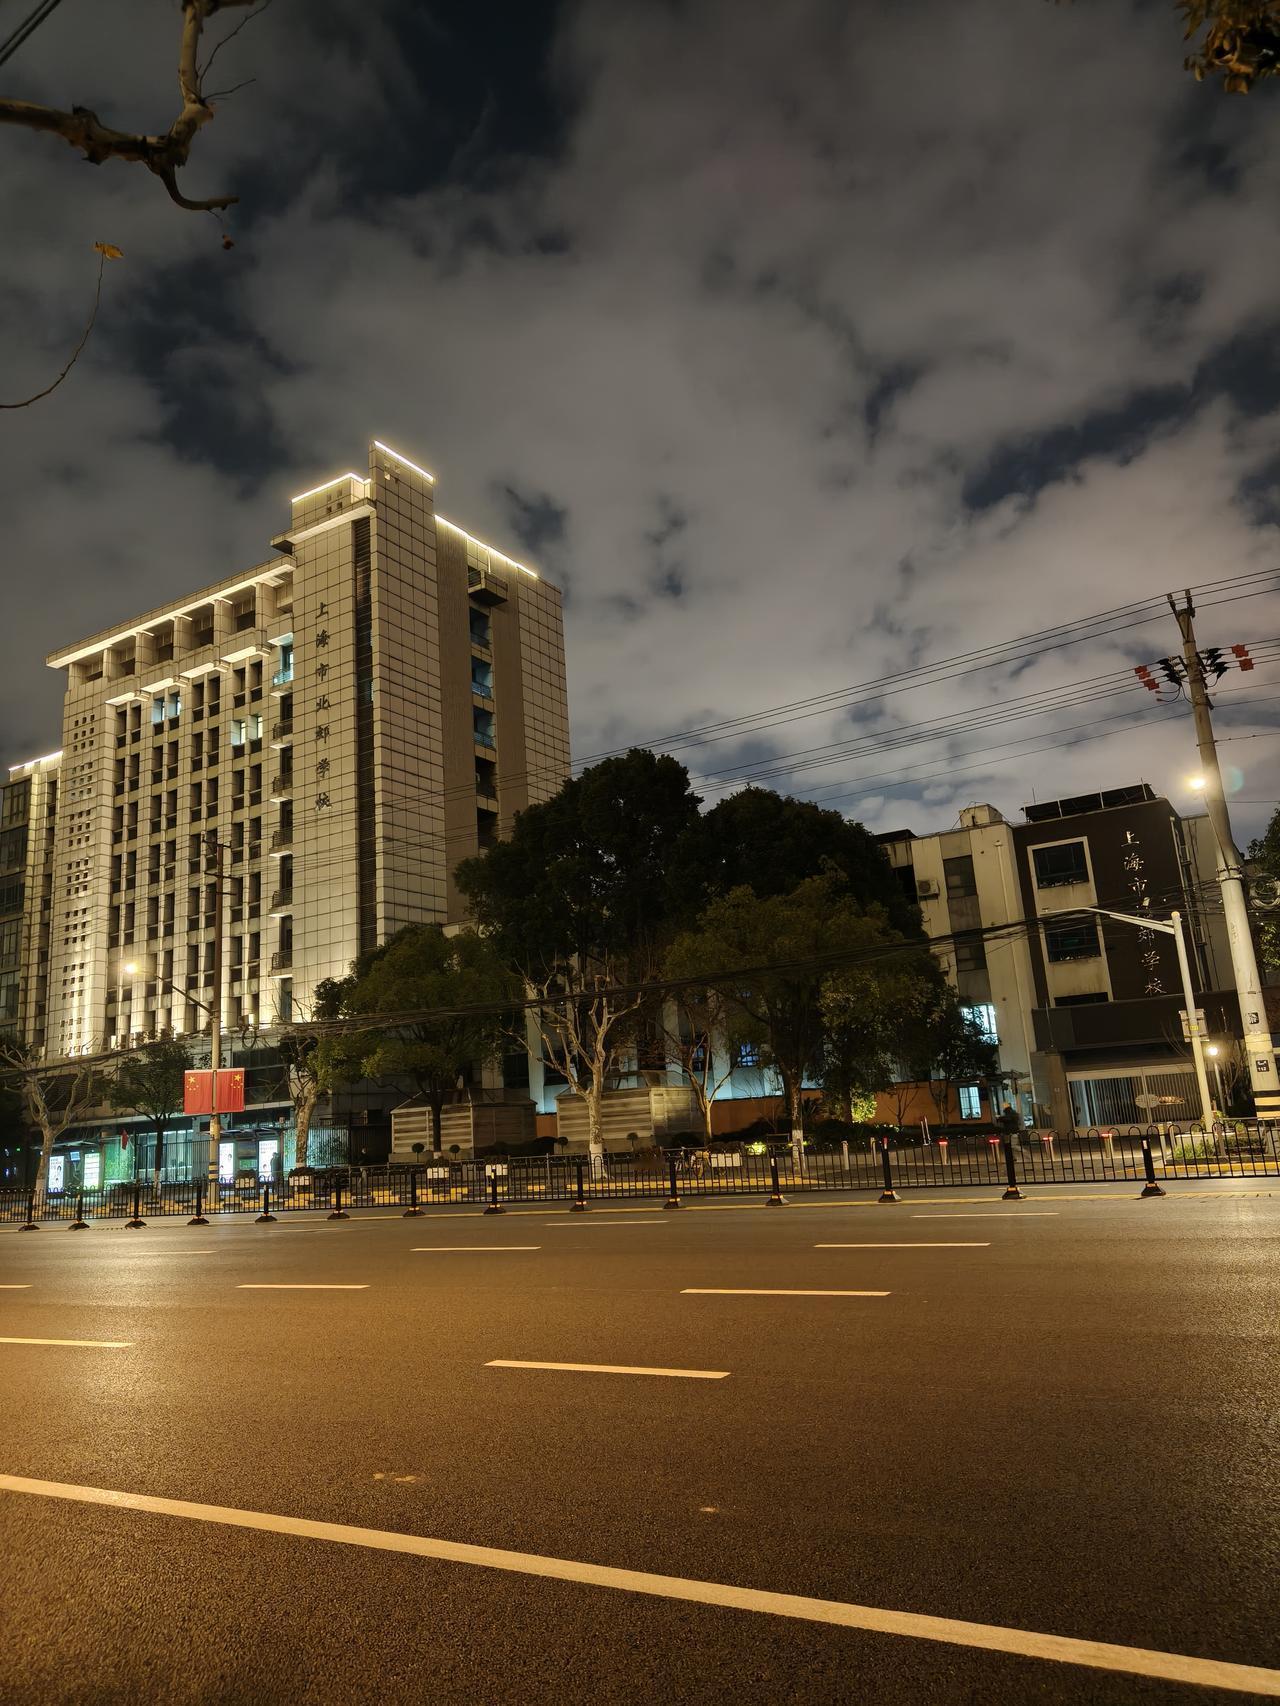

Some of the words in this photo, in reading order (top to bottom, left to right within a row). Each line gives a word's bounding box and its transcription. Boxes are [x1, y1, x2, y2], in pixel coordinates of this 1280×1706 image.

[1121, 830, 1167, 995] 上海市郊学校
